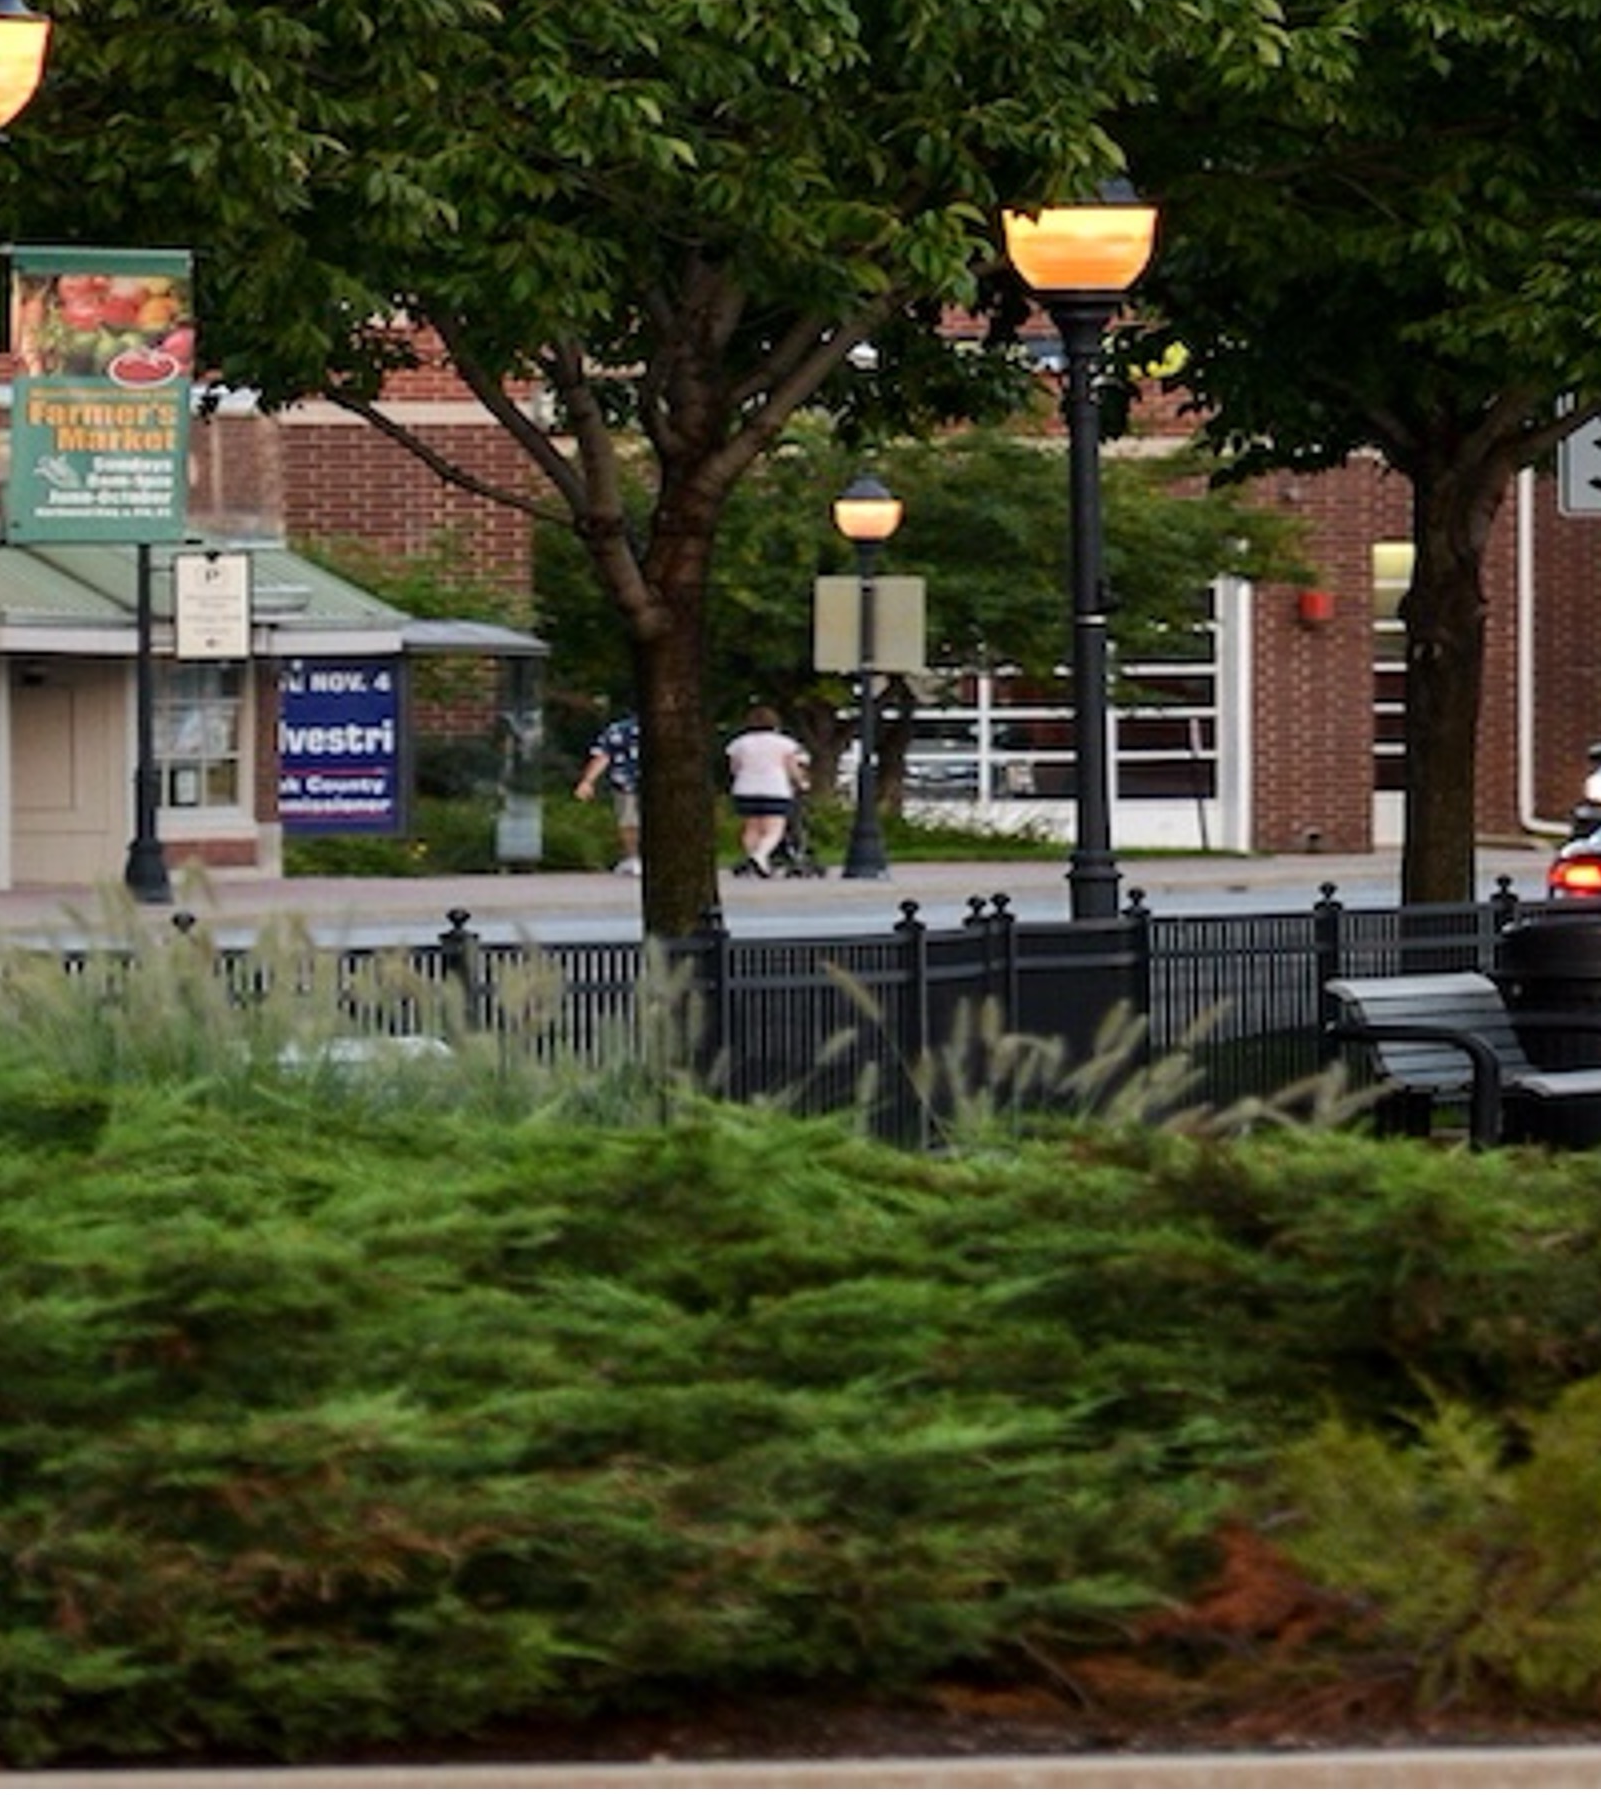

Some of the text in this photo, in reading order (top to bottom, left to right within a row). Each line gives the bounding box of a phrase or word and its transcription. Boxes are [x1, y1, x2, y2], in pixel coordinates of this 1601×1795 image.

[28, 400, 178, 426] Farmer's
[56, 426, 177, 451] Market
[309, 672, 368, 693] NOV.
[373, 672, 392, 692] 4
